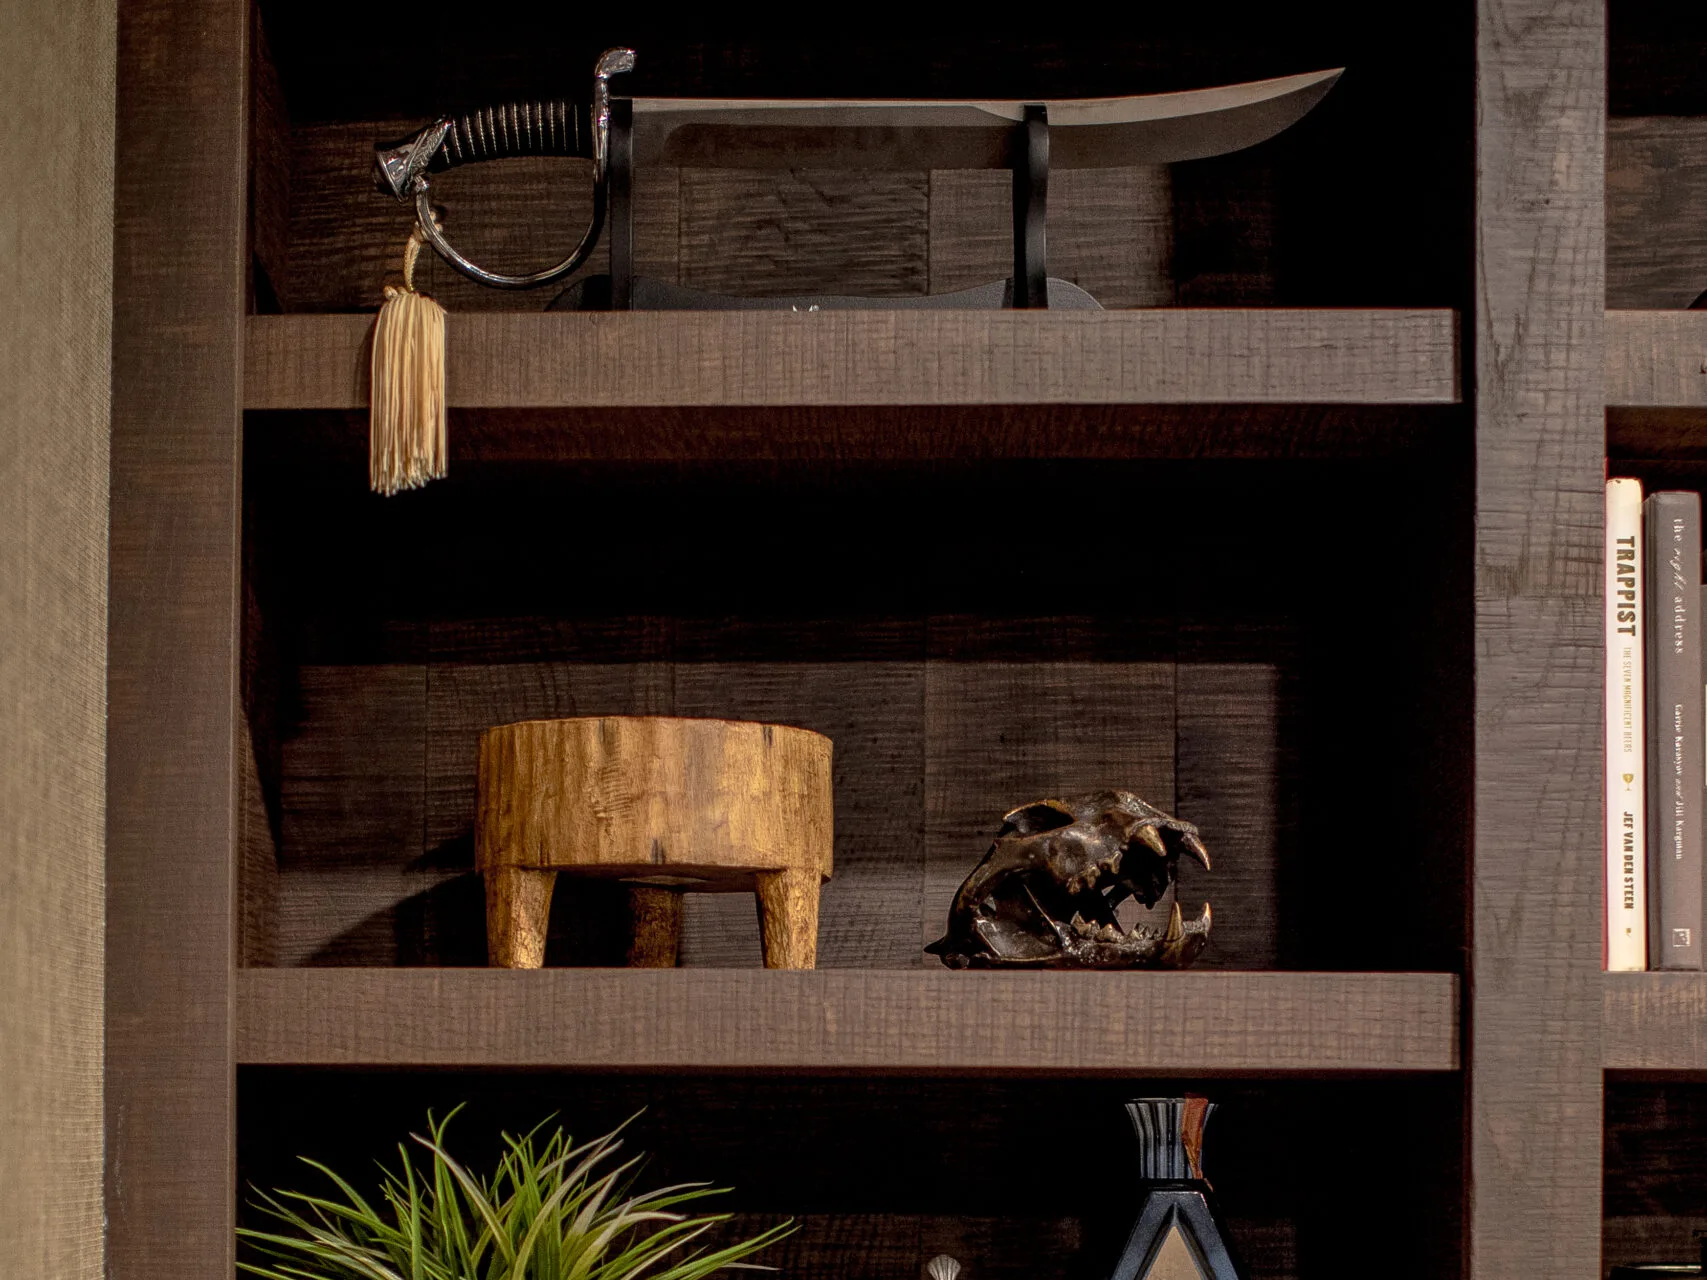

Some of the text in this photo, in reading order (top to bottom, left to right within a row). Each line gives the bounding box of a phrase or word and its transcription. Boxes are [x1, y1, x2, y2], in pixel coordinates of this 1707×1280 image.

[1616, 536, 1636, 636] TRAPPIST
[1669, 518, 1686, 655] the right address
[1622, 647, 1632, 659] THE
[1622, 660, 1632, 682] SEVEN
[1623, 684, 1633, 729] MAGNIFICENT
[1675, 801, 1685, 817] Jill
[1623, 811, 1635, 910] JEF VAN DEN STEEN
